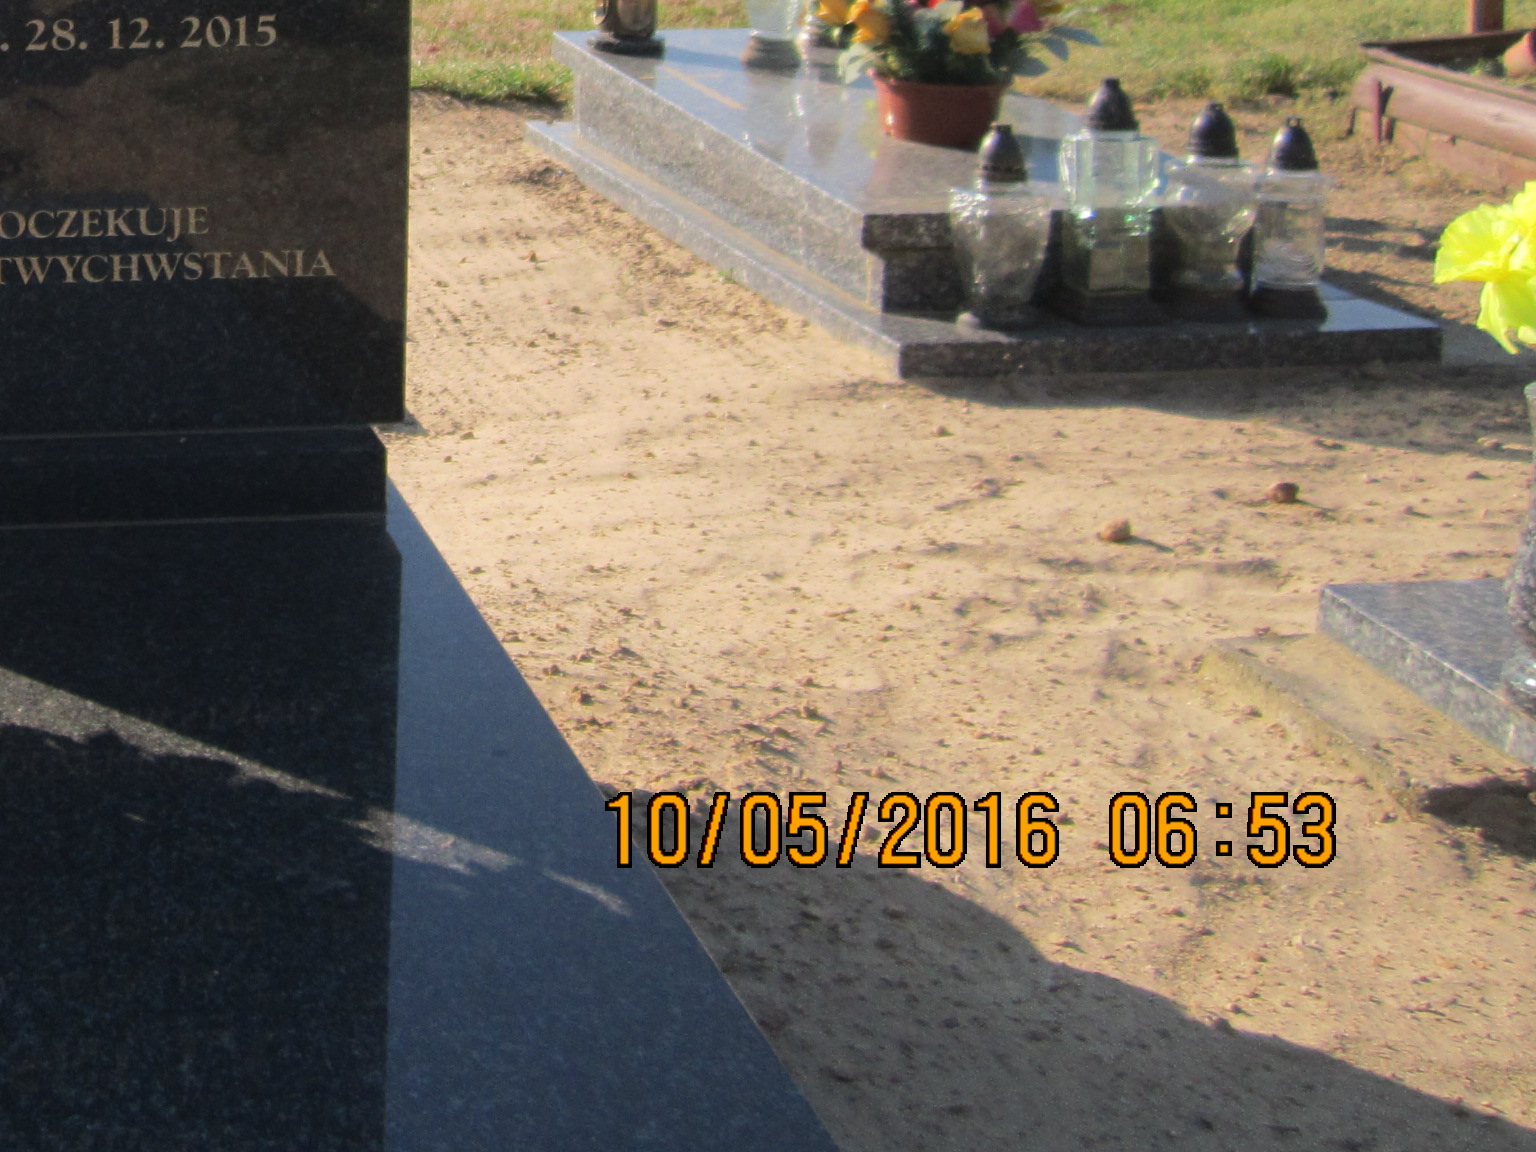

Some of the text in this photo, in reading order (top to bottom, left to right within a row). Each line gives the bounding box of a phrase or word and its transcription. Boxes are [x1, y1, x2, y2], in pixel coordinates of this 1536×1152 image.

[24, 18, 88, 51] 28.
[108, 17, 165, 50] 12.
[180, 14, 278, 48] 2015
